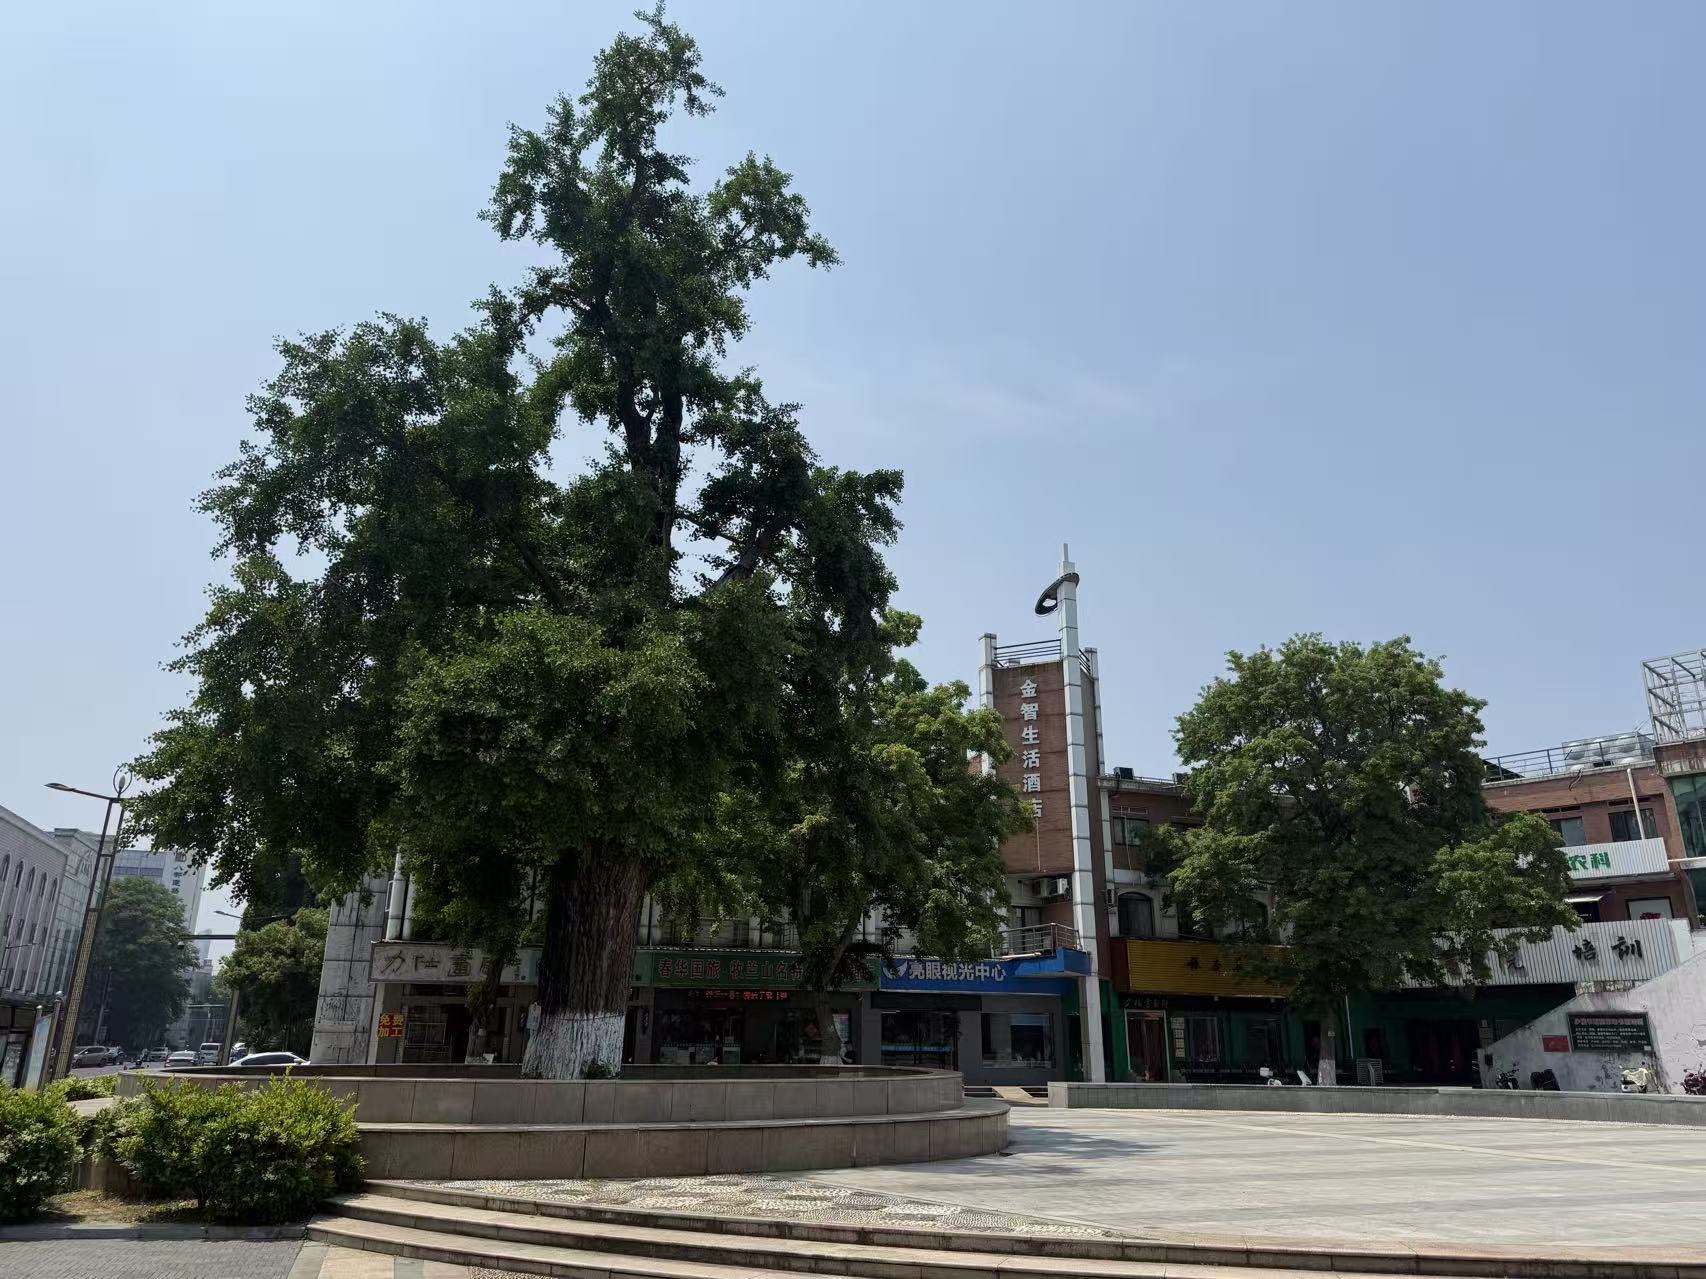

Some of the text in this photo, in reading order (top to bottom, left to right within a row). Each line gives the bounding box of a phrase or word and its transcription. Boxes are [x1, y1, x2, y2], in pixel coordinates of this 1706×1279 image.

[1020, 679, 1042, 818] 金智生活酒店
[1572, 936, 1643, 961] 培训
[659, 957, 721, 979] 春华国旅
[909, 960, 1007, 983] 亮眼视光中心
[379, 1013, 404, 1026] 免费
[377, 1026, 403, 1038] 加工
